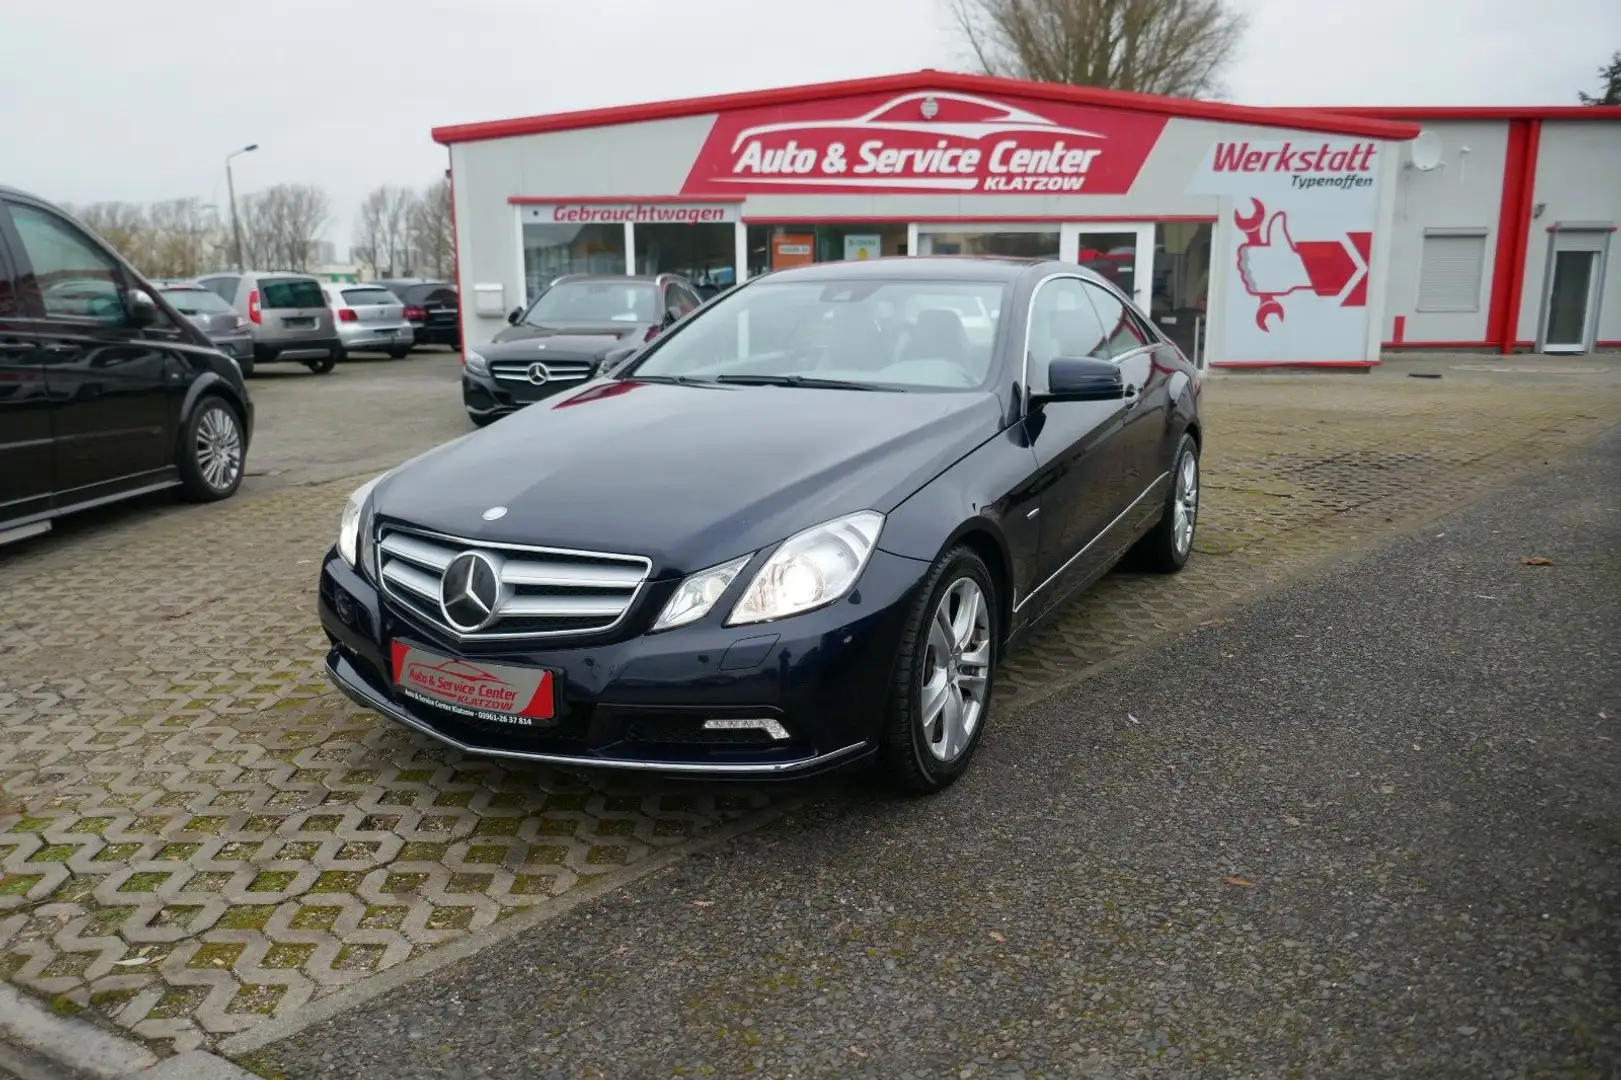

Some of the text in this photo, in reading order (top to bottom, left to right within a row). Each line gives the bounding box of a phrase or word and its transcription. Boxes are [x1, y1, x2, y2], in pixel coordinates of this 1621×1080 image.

[732, 140, 1102, 173] Auto & Service Center
[1213, 142, 1377, 172] Werkstatt
[983, 176, 1085, 190] KLATZOW
[1291, 175, 1373, 190] Typenoffen
[553, 204, 724, 225] Gebrauchtwagen
[408, 669, 518, 701] Auto & Service Center
[419, 694, 435, 706] Service
[435, 700, 452, 711] Center
[478, 711, 508, 723] 03961-26
[509, 716, 517, 724] 37
[518, 717, 532, 726] 814
[456, 695, 514, 711] KLATZOW
